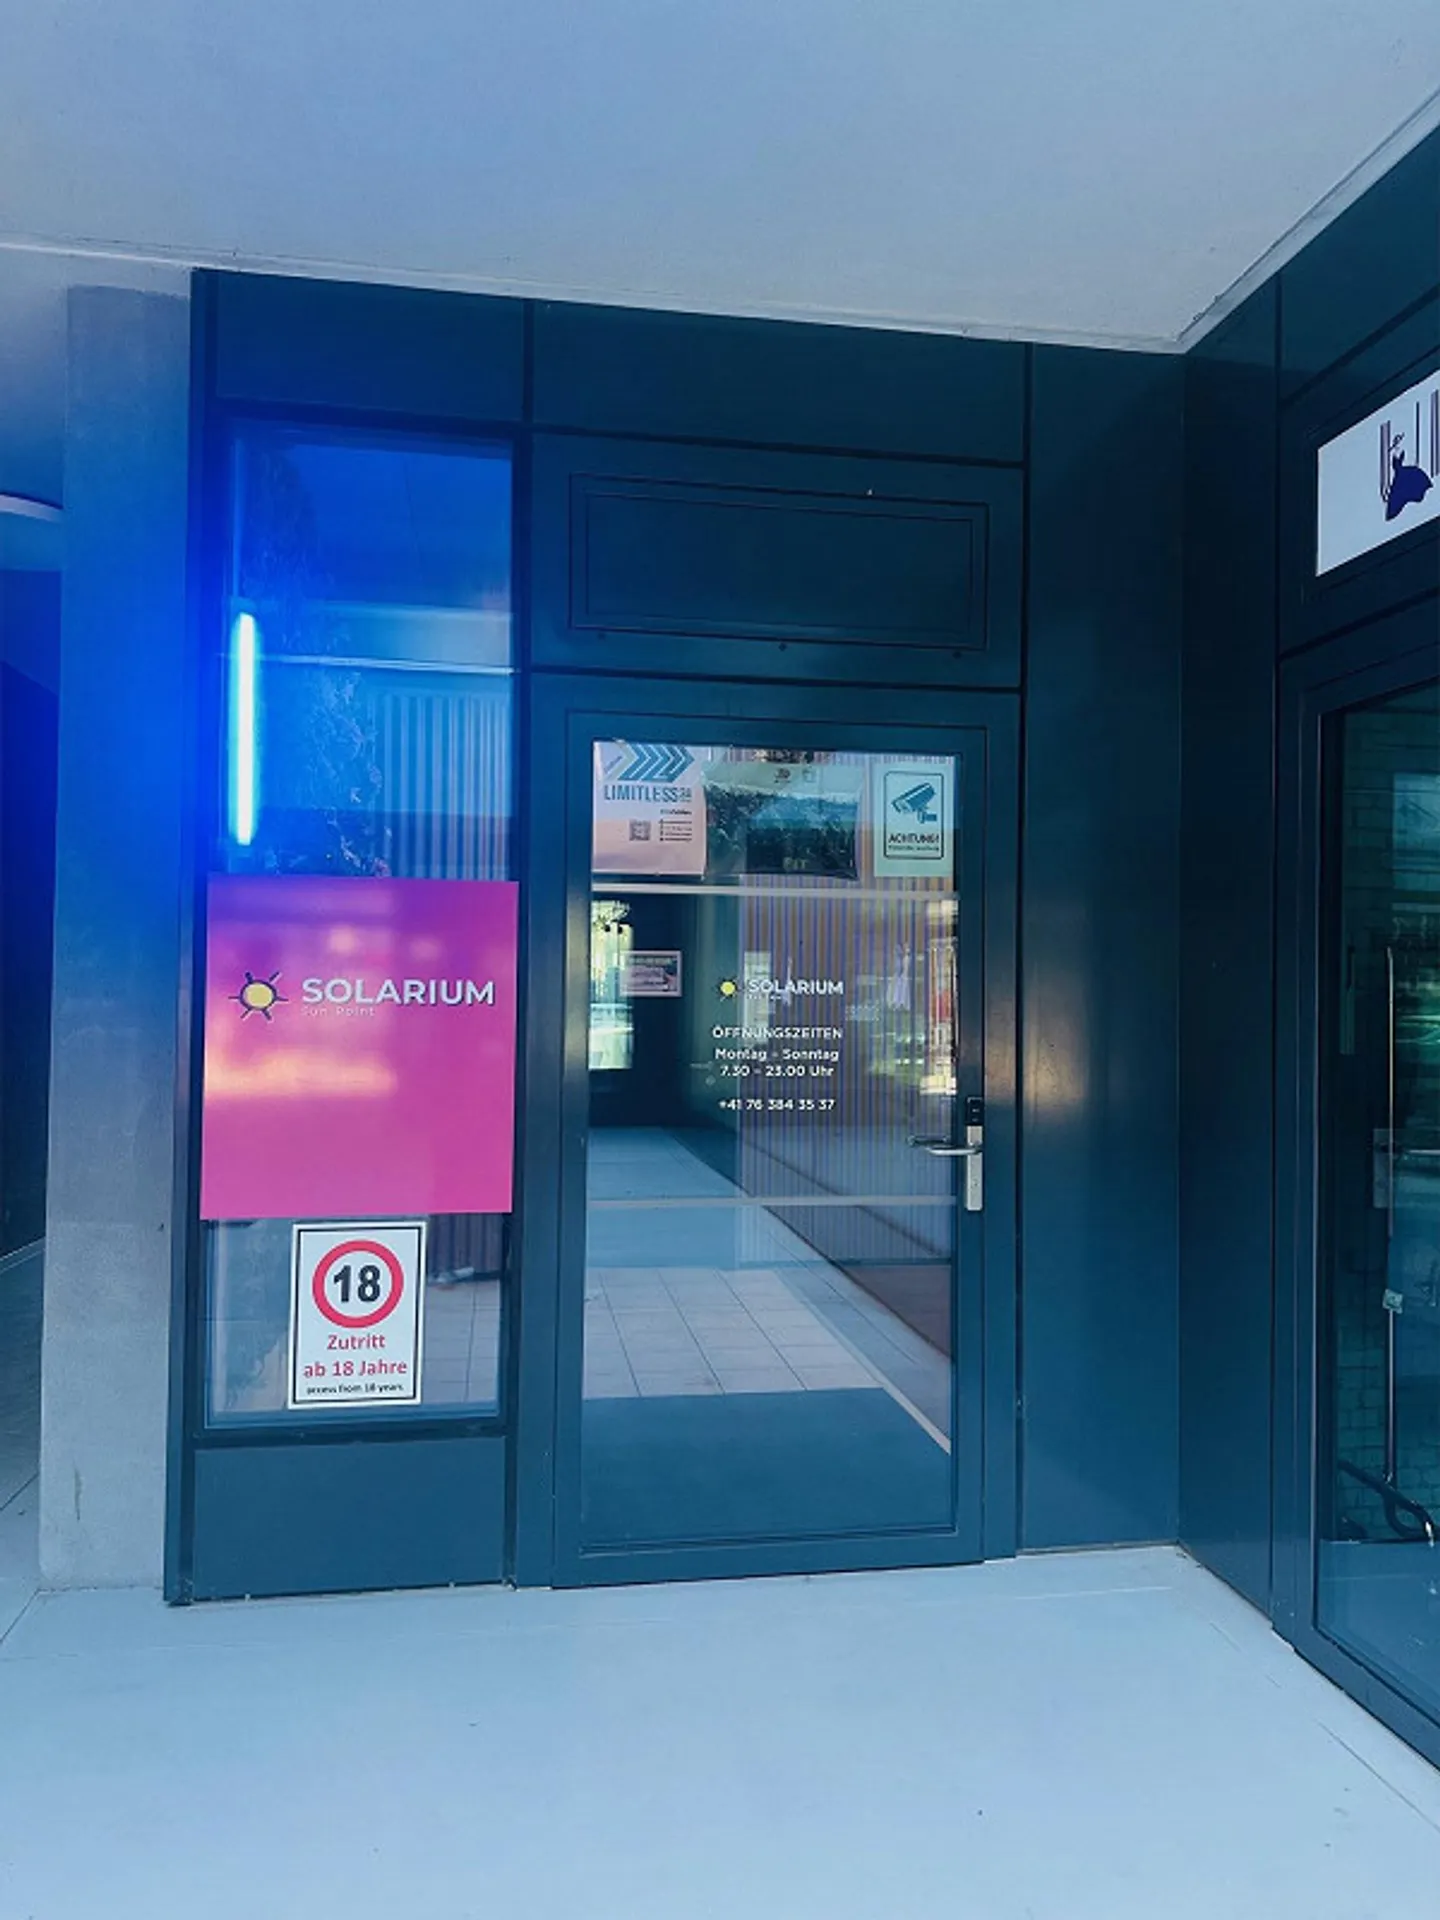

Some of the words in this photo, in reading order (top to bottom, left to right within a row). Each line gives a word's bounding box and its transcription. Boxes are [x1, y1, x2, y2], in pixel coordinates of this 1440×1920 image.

[604, 785, 679, 802] LIMITLESS
[302, 978, 495, 1006] SOLARIUM
[748, 980, 844, 995] SOLARIUM
[712, 1025, 842, 1039] ÖFFNUNGSZEITEN
[714, 1048, 767, 1062] Montag
[782, 1048, 839, 1062] Sonntag
[809, 1065, 834, 1077] Uhr
[333, 1264, 381, 1303] 18
[326, 1333, 386, 1351] Zutritt
[303, 1361, 327, 1379] ab
[332, 1360, 355, 1377] 18
[358, 1358, 408, 1376] Jahre
